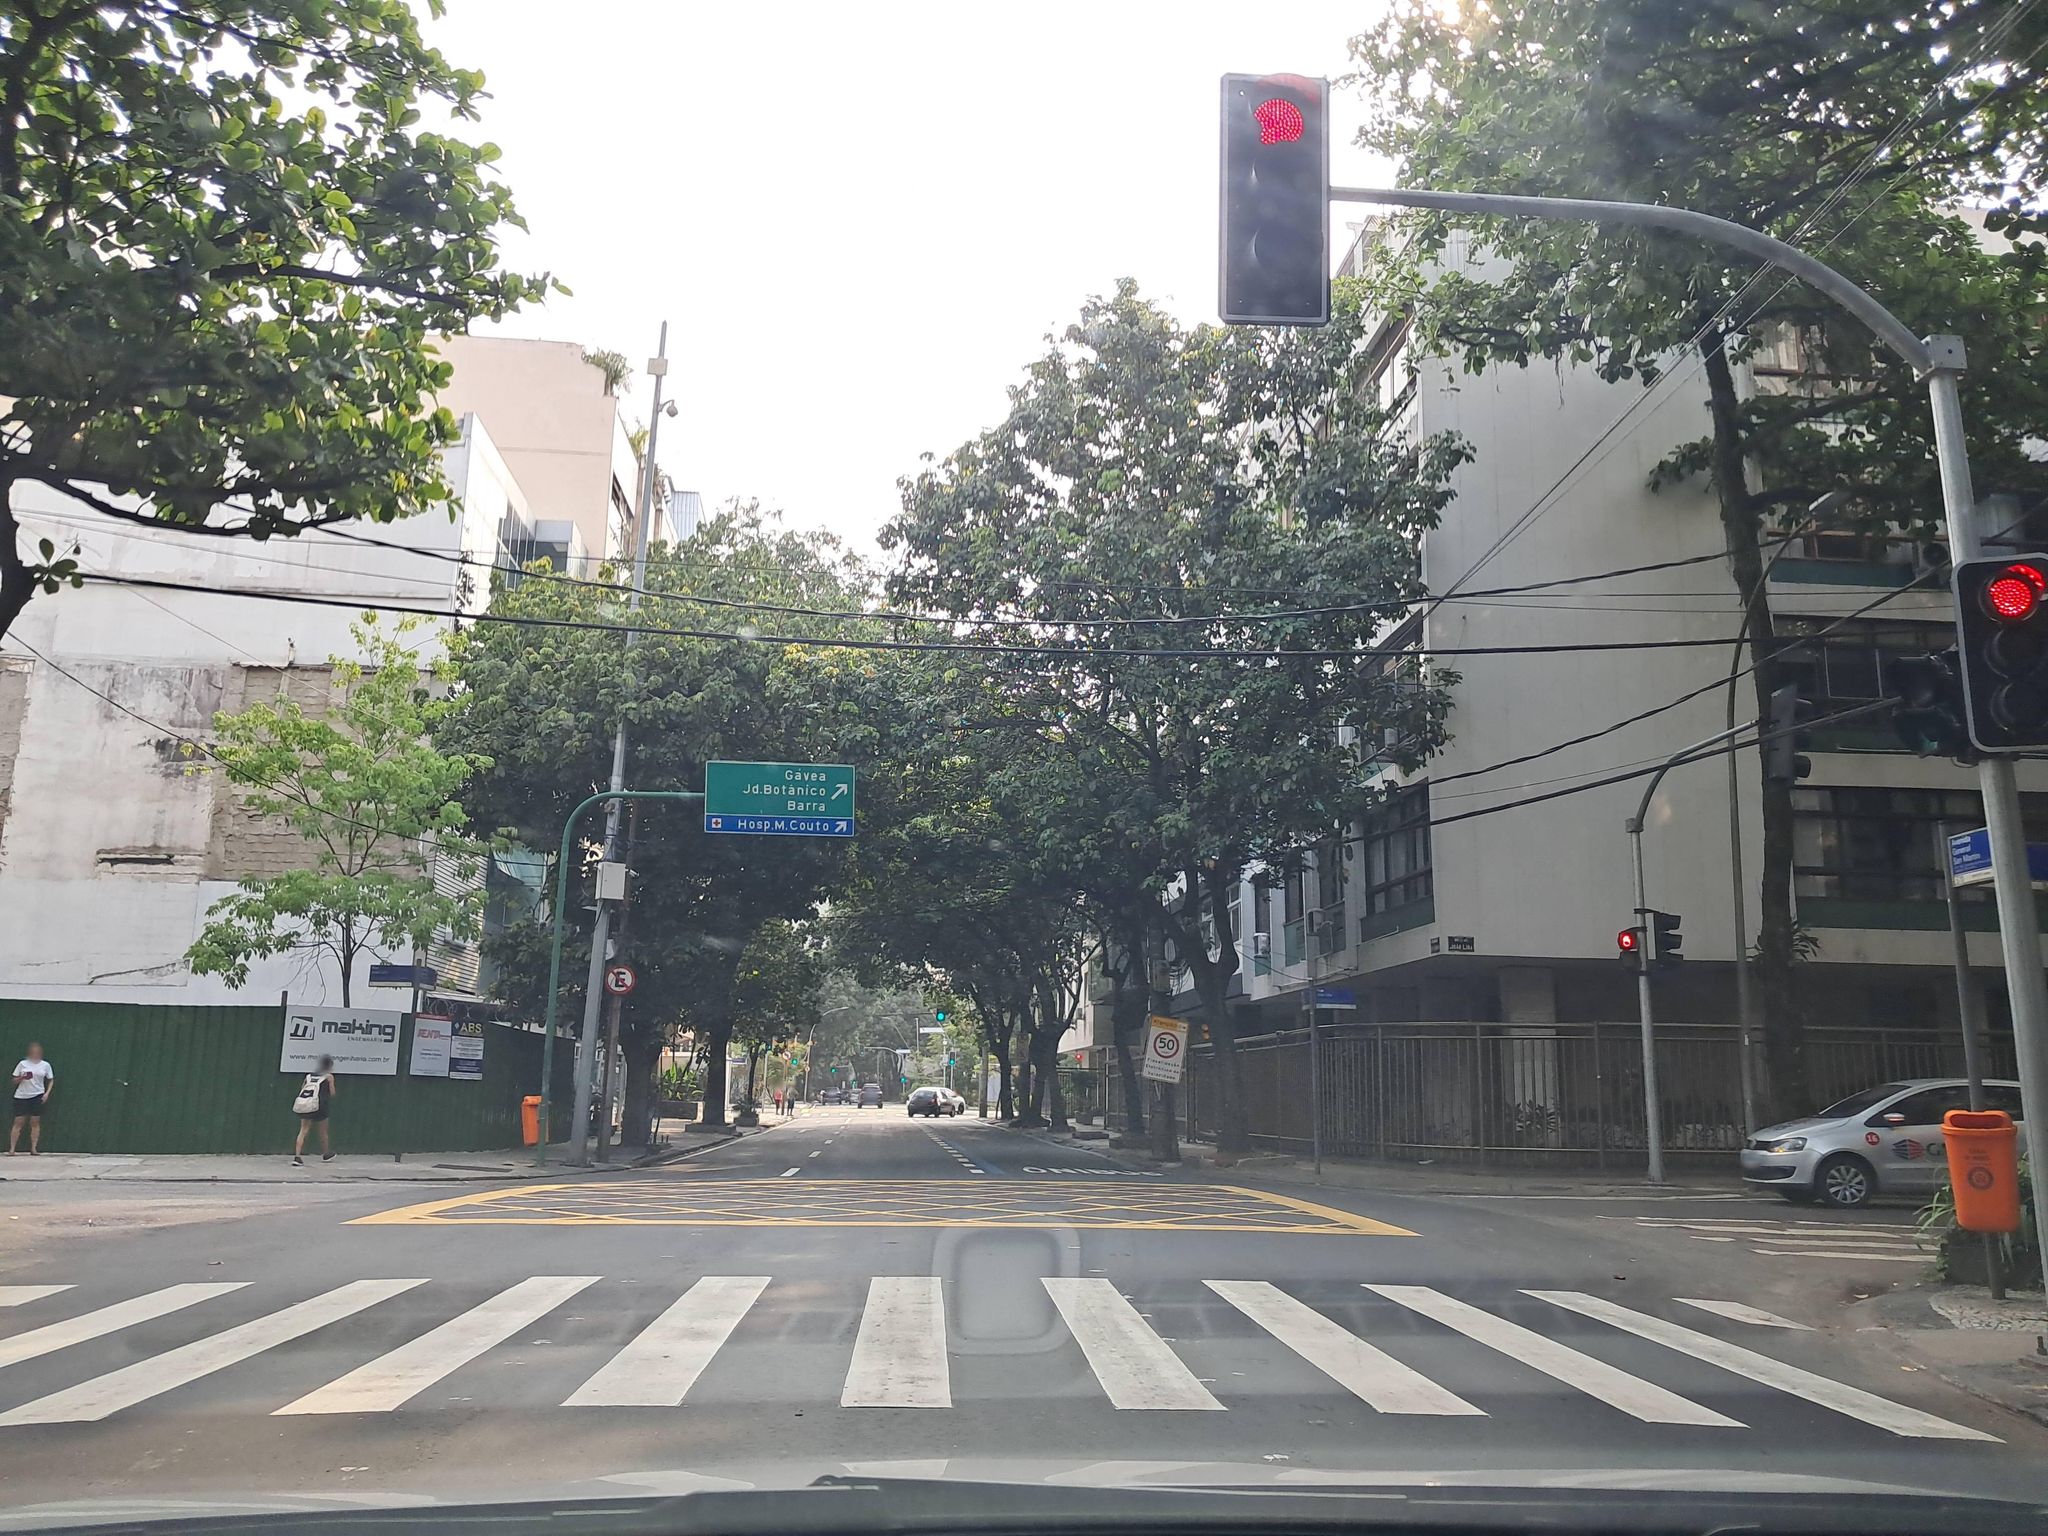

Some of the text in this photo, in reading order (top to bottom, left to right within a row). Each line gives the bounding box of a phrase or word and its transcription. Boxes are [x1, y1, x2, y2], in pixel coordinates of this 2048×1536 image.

[785, 768, 826, 781] Gávea
[787, 801, 825, 811] Barra
[738, 819, 829, 832] Hosp.M.Couto
[321, 1018, 396, 1043] making
[460, 1022, 482, 1033] ABS
[1158, 1037, 1175, 1051] 50
